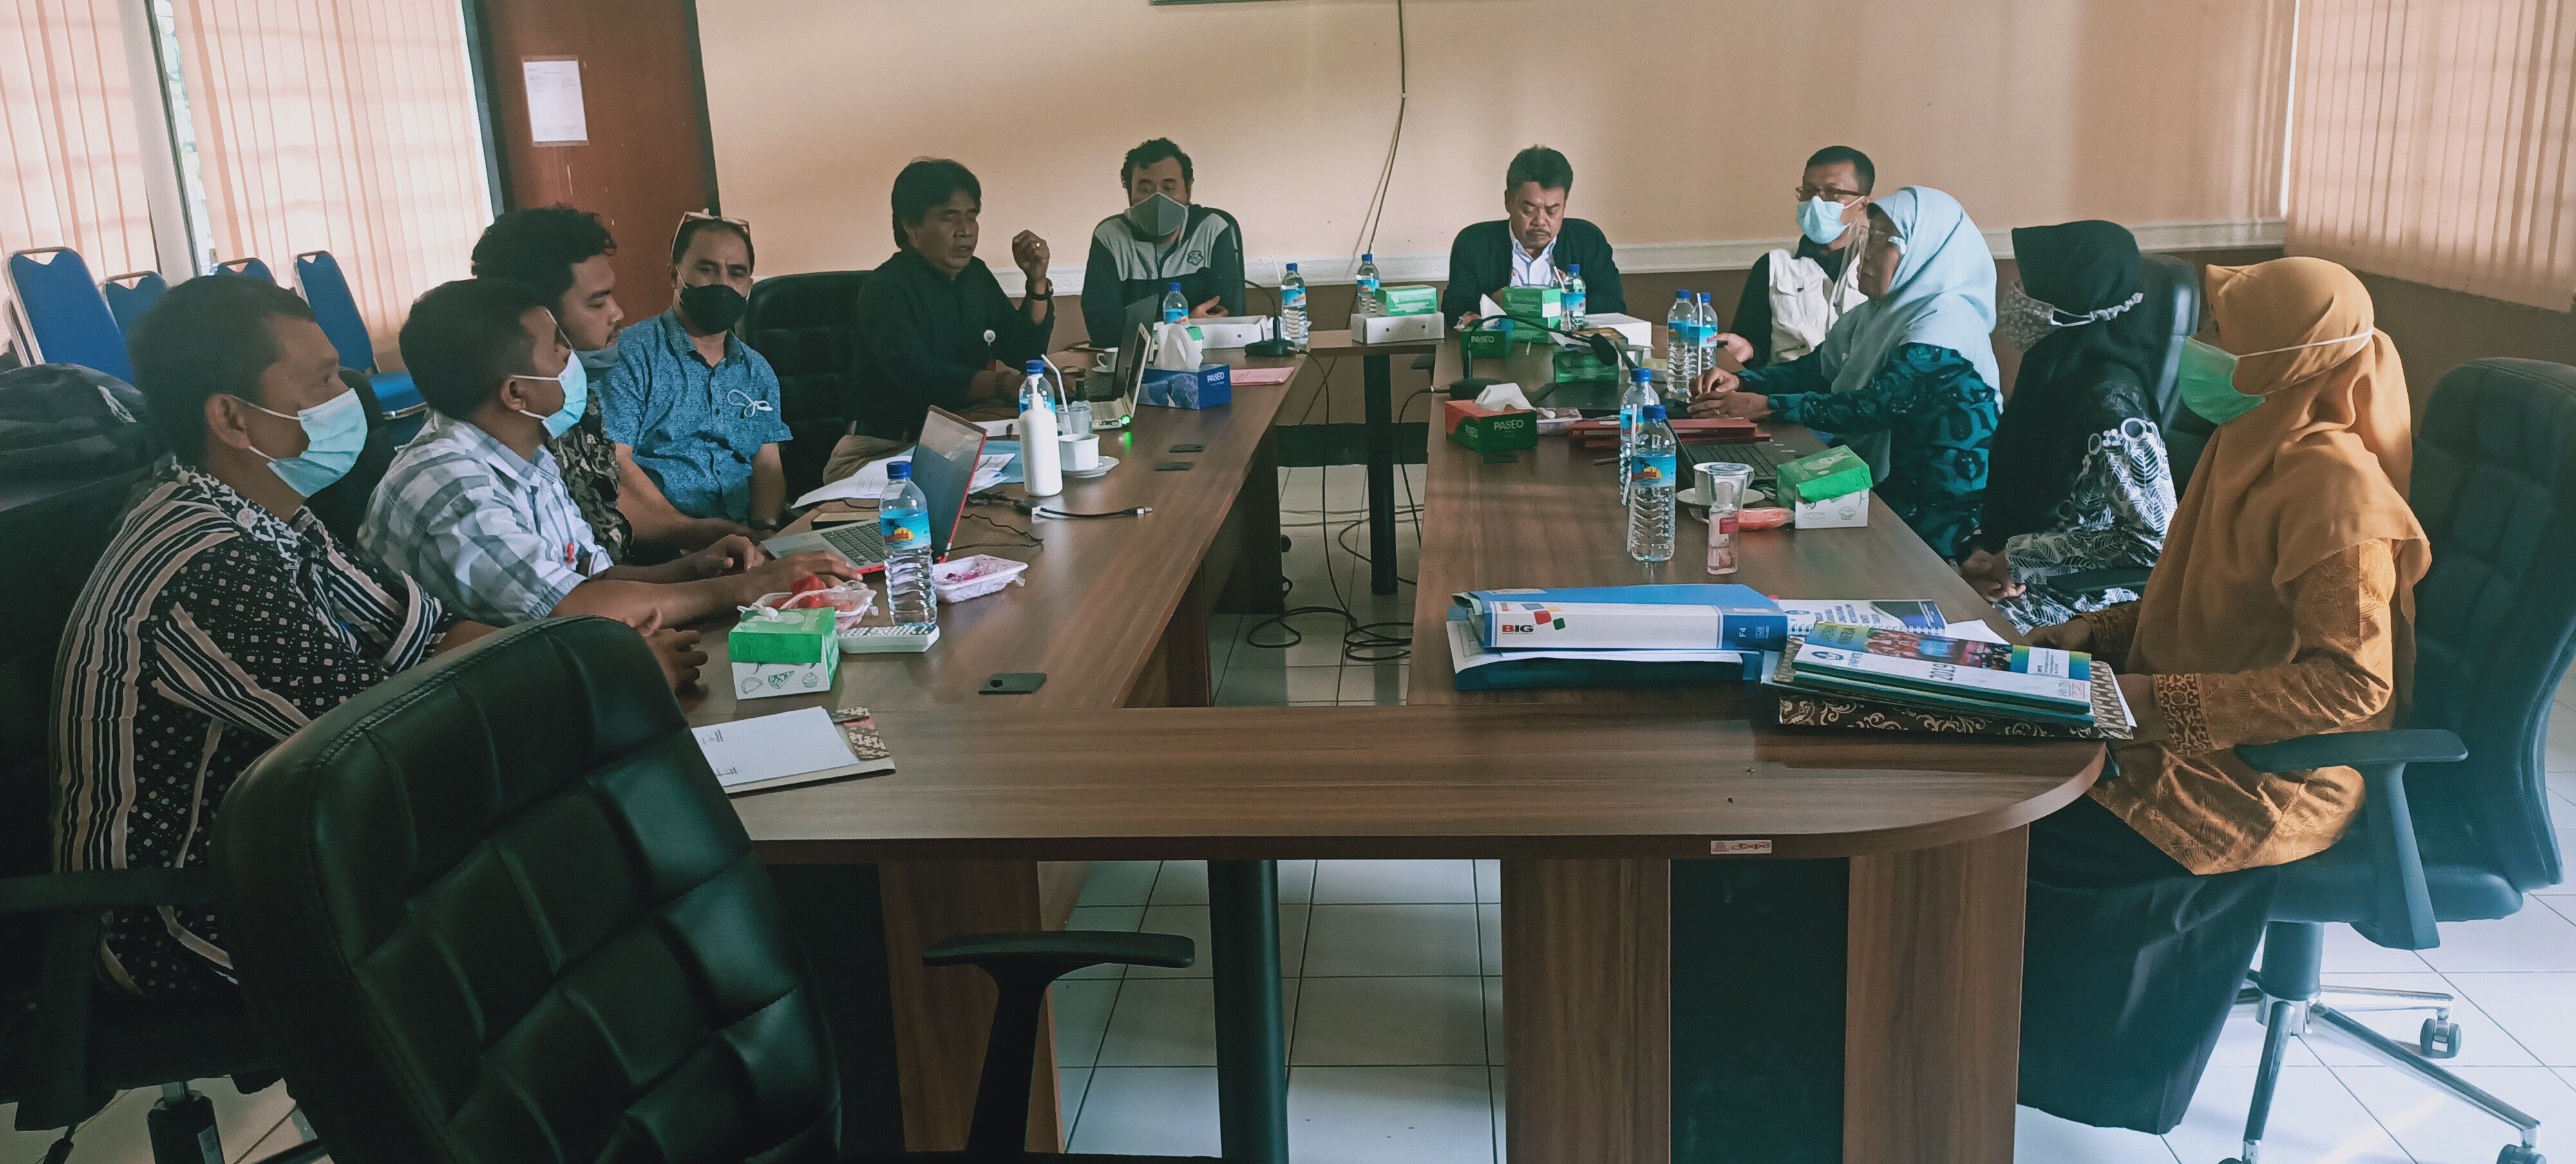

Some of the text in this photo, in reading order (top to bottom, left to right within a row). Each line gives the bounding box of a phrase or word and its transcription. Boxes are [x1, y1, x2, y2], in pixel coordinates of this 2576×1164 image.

[1207, 371, 1225, 383] PASEO
[1494, 419, 1524, 430] PASEO
[1502, 624, 1534, 633] BIG
[1739, 627, 1747, 637] F4
[1930, 663, 1956, 681] 2019
